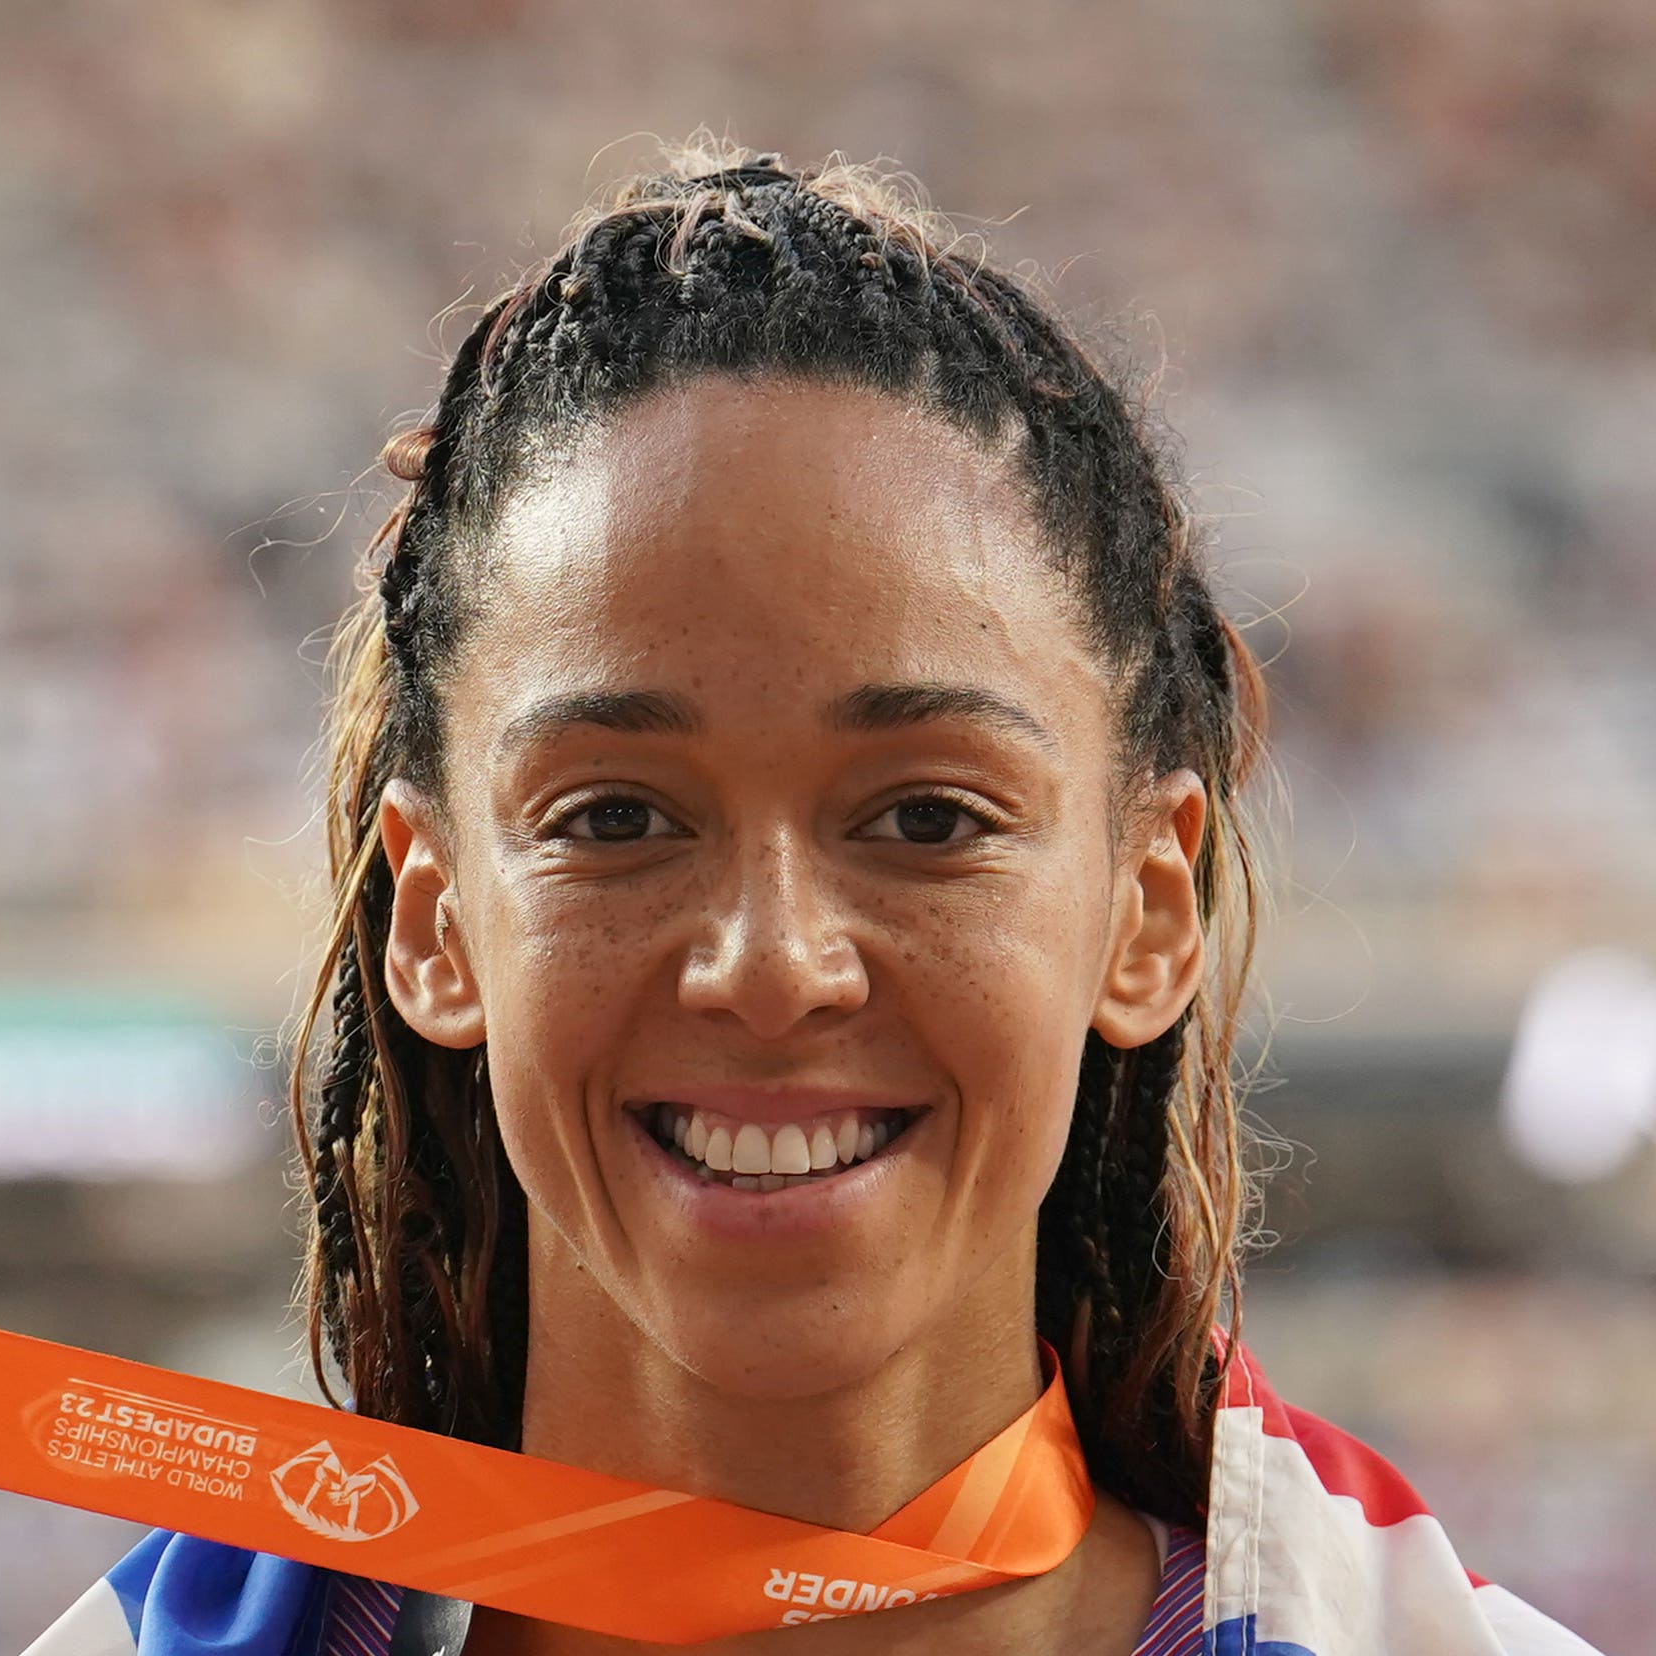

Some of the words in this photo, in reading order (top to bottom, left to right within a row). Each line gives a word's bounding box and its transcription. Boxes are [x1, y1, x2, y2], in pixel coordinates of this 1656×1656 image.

[59, 1391, 95, 1418] 23
[53, 1416, 252, 1481] CHAMPIONSHIPS
[95, 1402, 258, 1458] BUDAPEST
[46, 1438, 163, 1481] ATHLETICS
[167, 1468, 245, 1502] WORLD
[762, 1567, 953, 1613] ONDER
